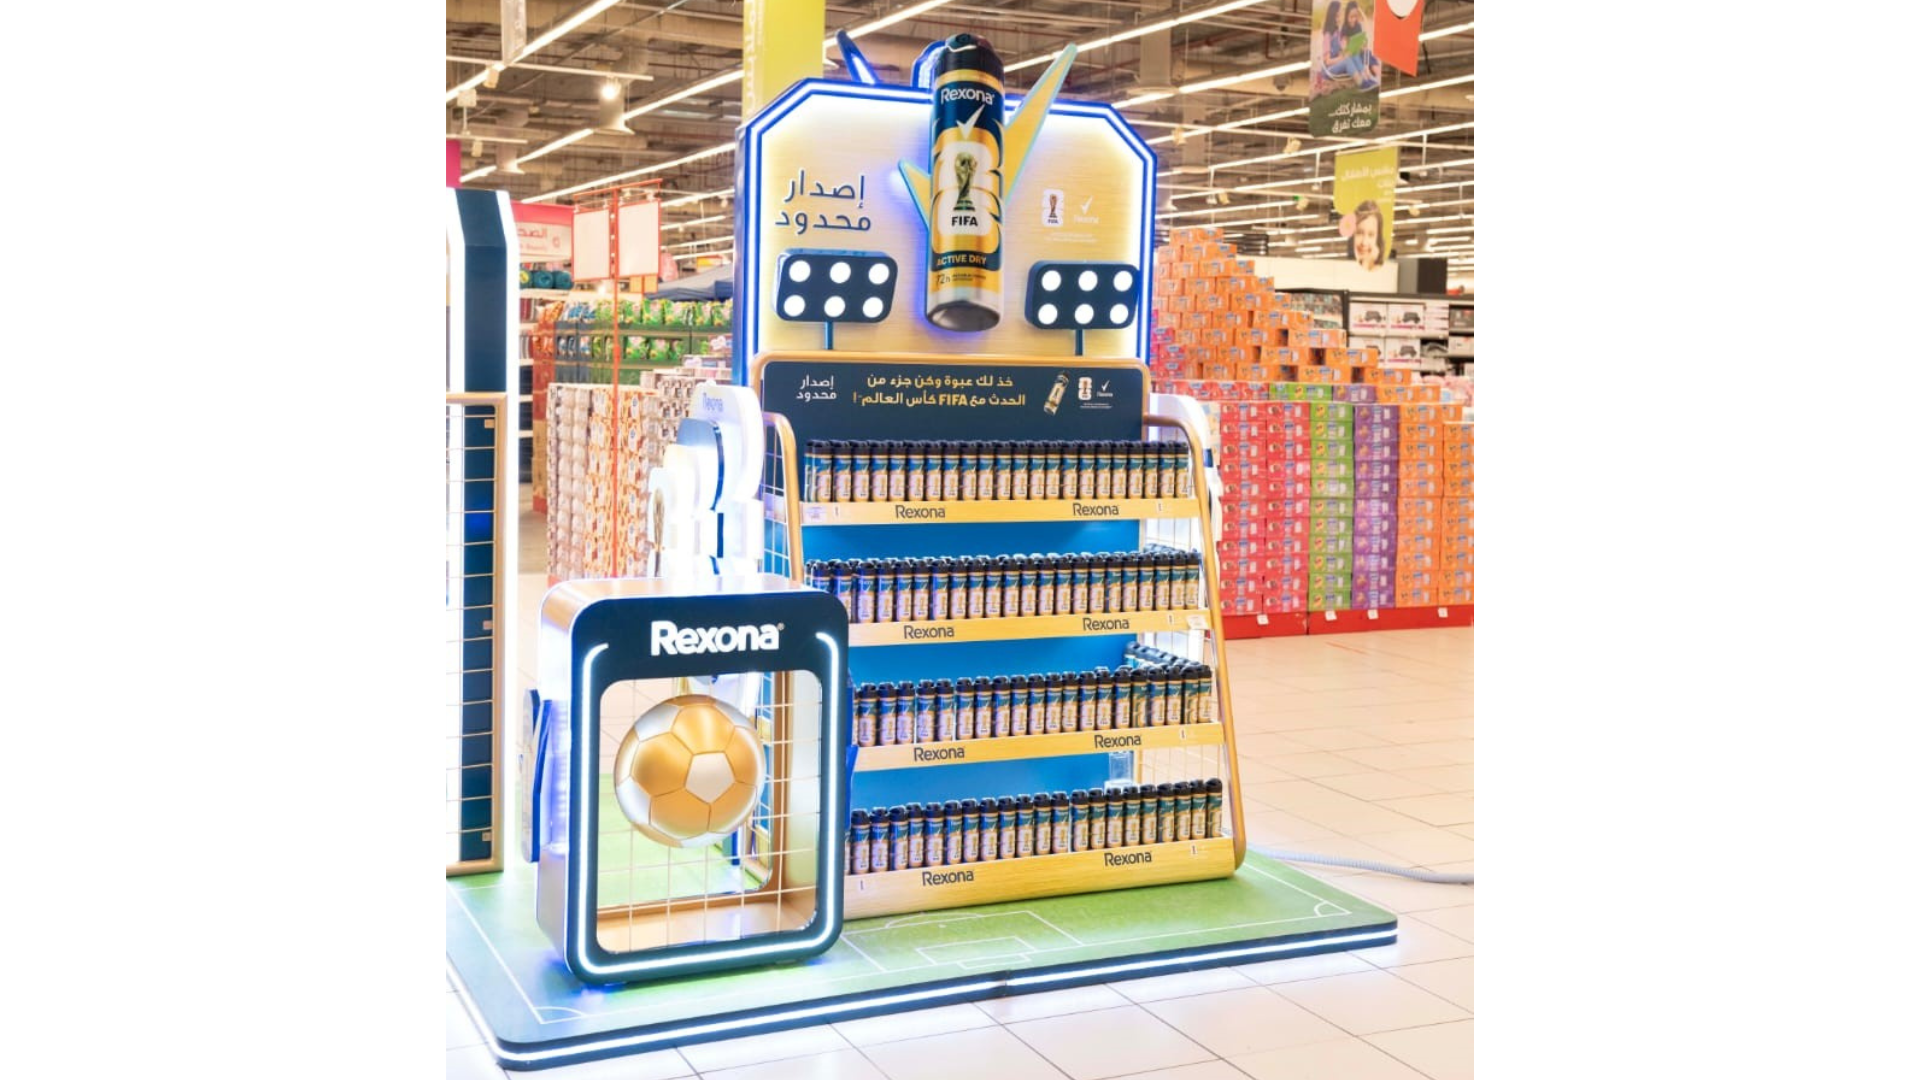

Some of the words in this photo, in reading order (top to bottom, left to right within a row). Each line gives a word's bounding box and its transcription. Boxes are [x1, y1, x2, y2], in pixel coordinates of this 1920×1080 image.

[941, 88, 992, 105] Rexona
[784, 170, 864, 209] إصدار
[775, 211, 871, 235] محدود
[951, 216, 978, 227] FIFA
[937, 255, 967, 265] ACTIVE
[969, 254, 986, 265] DRY
[800, 374, 834, 390] إصدار
[867, 374, 886, 387] من
[890, 375, 912, 388] جزء
[914, 374, 941, 388] وكن
[945, 375, 973, 388] عبوة
[976, 375, 993, 387] لك
[997, 375, 1013, 387] خذ
[796, 391, 837, 402] محدود
[906, 390, 936, 407] كأس
[938, 394, 967, 406] FIFA
[969, 396, 986, 407] مع
[989, 394, 1026, 406] الحدث
[895, 504, 946, 519] Rexona
[1073, 503, 1119, 516] Rexona
[1083, 617, 1130, 631] Rexona
[651, 620, 780, 656] Rexona
[904, 625, 955, 639] Rexona
[1094, 734, 1141, 749] Rexona
[914, 747, 965, 762] Rexona
[1104, 852, 1152, 867] Rexona
[922, 870, 974, 886] Rexona
